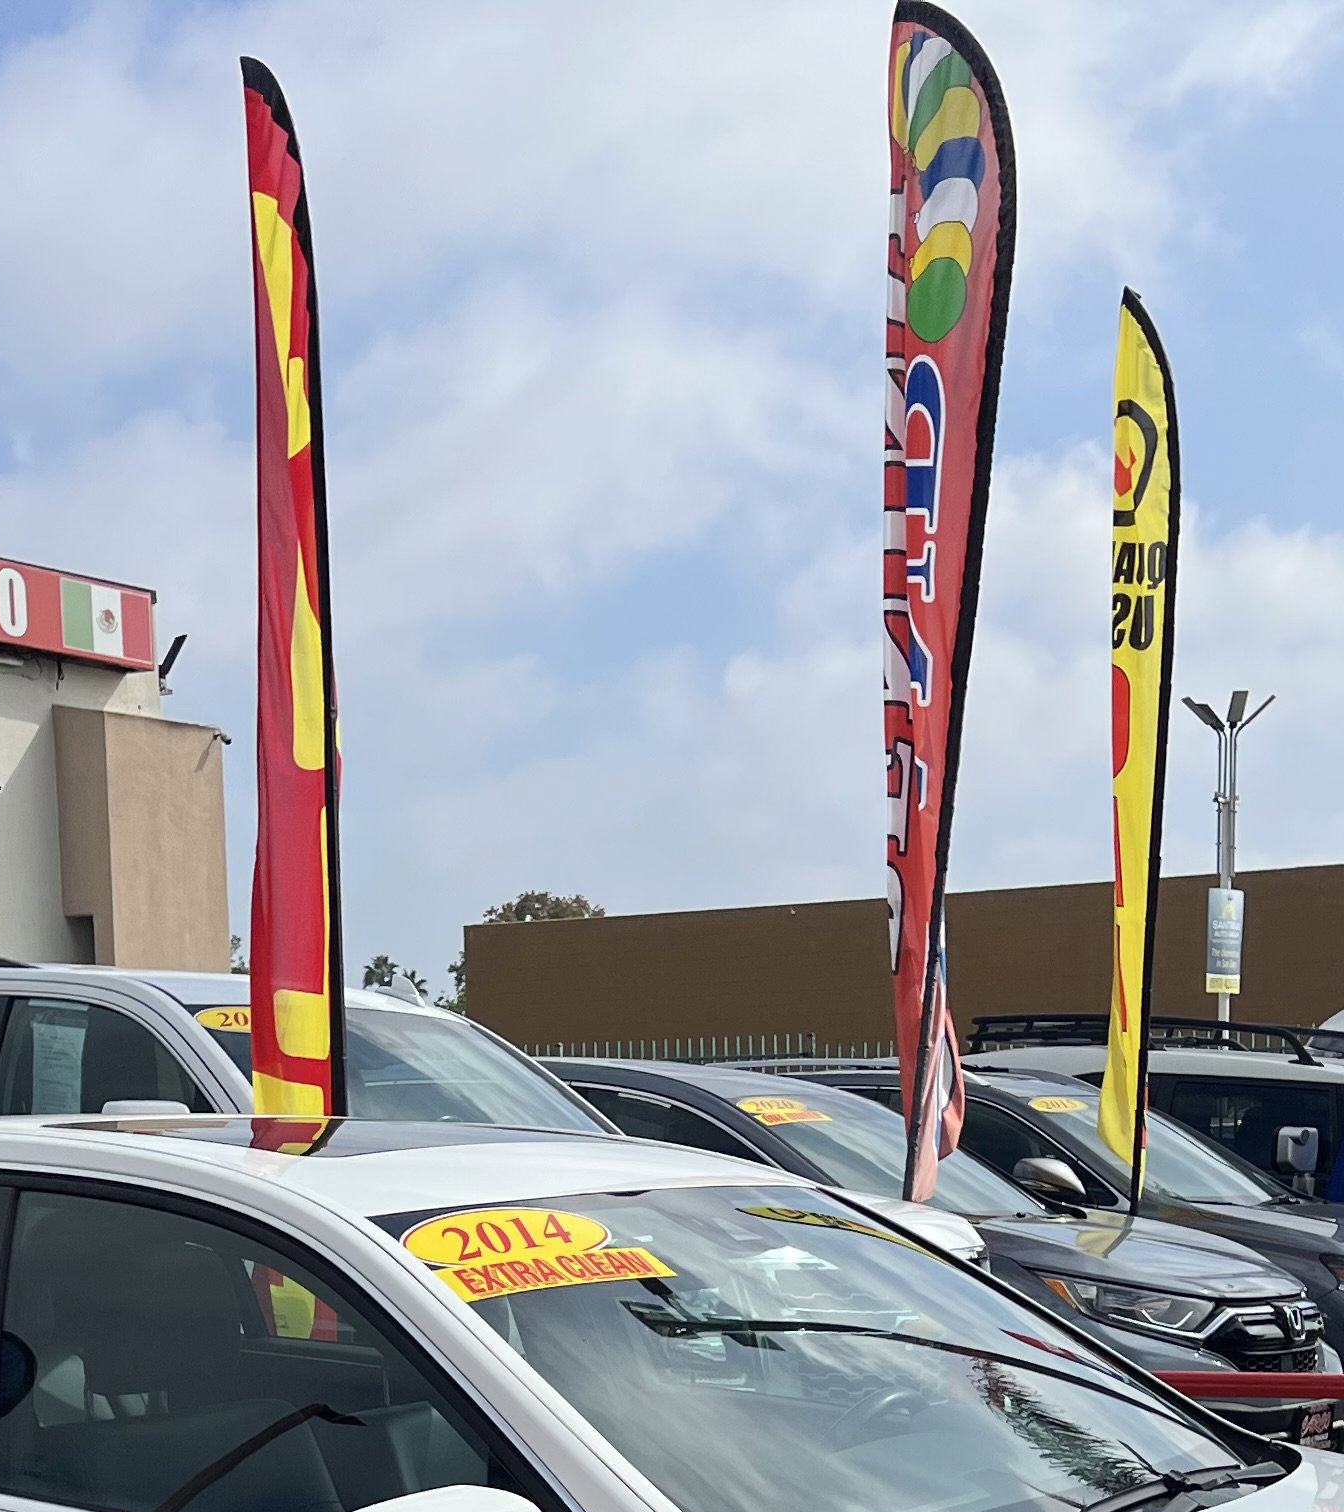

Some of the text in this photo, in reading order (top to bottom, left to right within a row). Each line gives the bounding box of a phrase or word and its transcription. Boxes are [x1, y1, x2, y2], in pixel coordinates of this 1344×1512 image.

[215, 1012, 249, 1028] 20
[441, 1213, 572, 1262] 2014
[455, 1250, 660, 1297] EXTRA CLEAN
